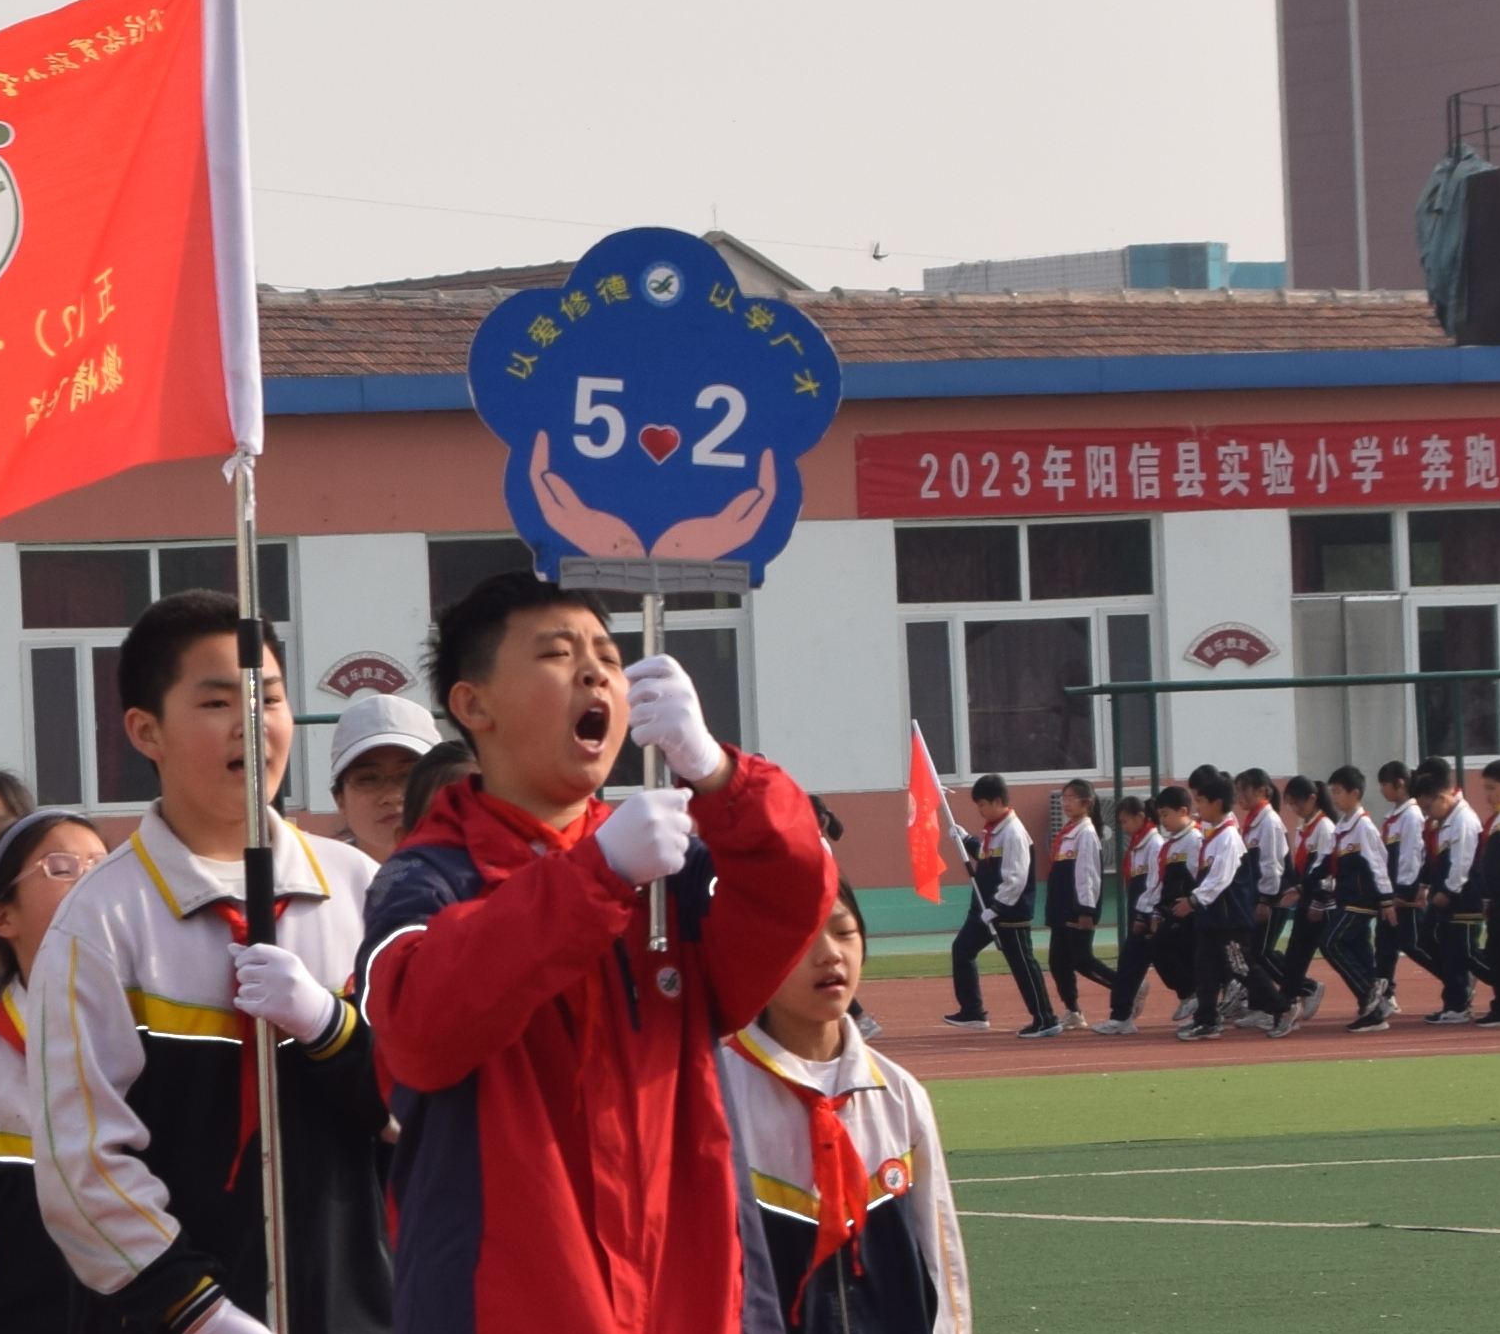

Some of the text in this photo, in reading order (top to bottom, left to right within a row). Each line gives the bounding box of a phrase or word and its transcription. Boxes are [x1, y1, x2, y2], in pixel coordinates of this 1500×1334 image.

[506, 274, 821, 399] 以爱修德 以学广才
[572, 376, 748, 468] 5 2
[337, 666, 398, 688] 音乐教室二
